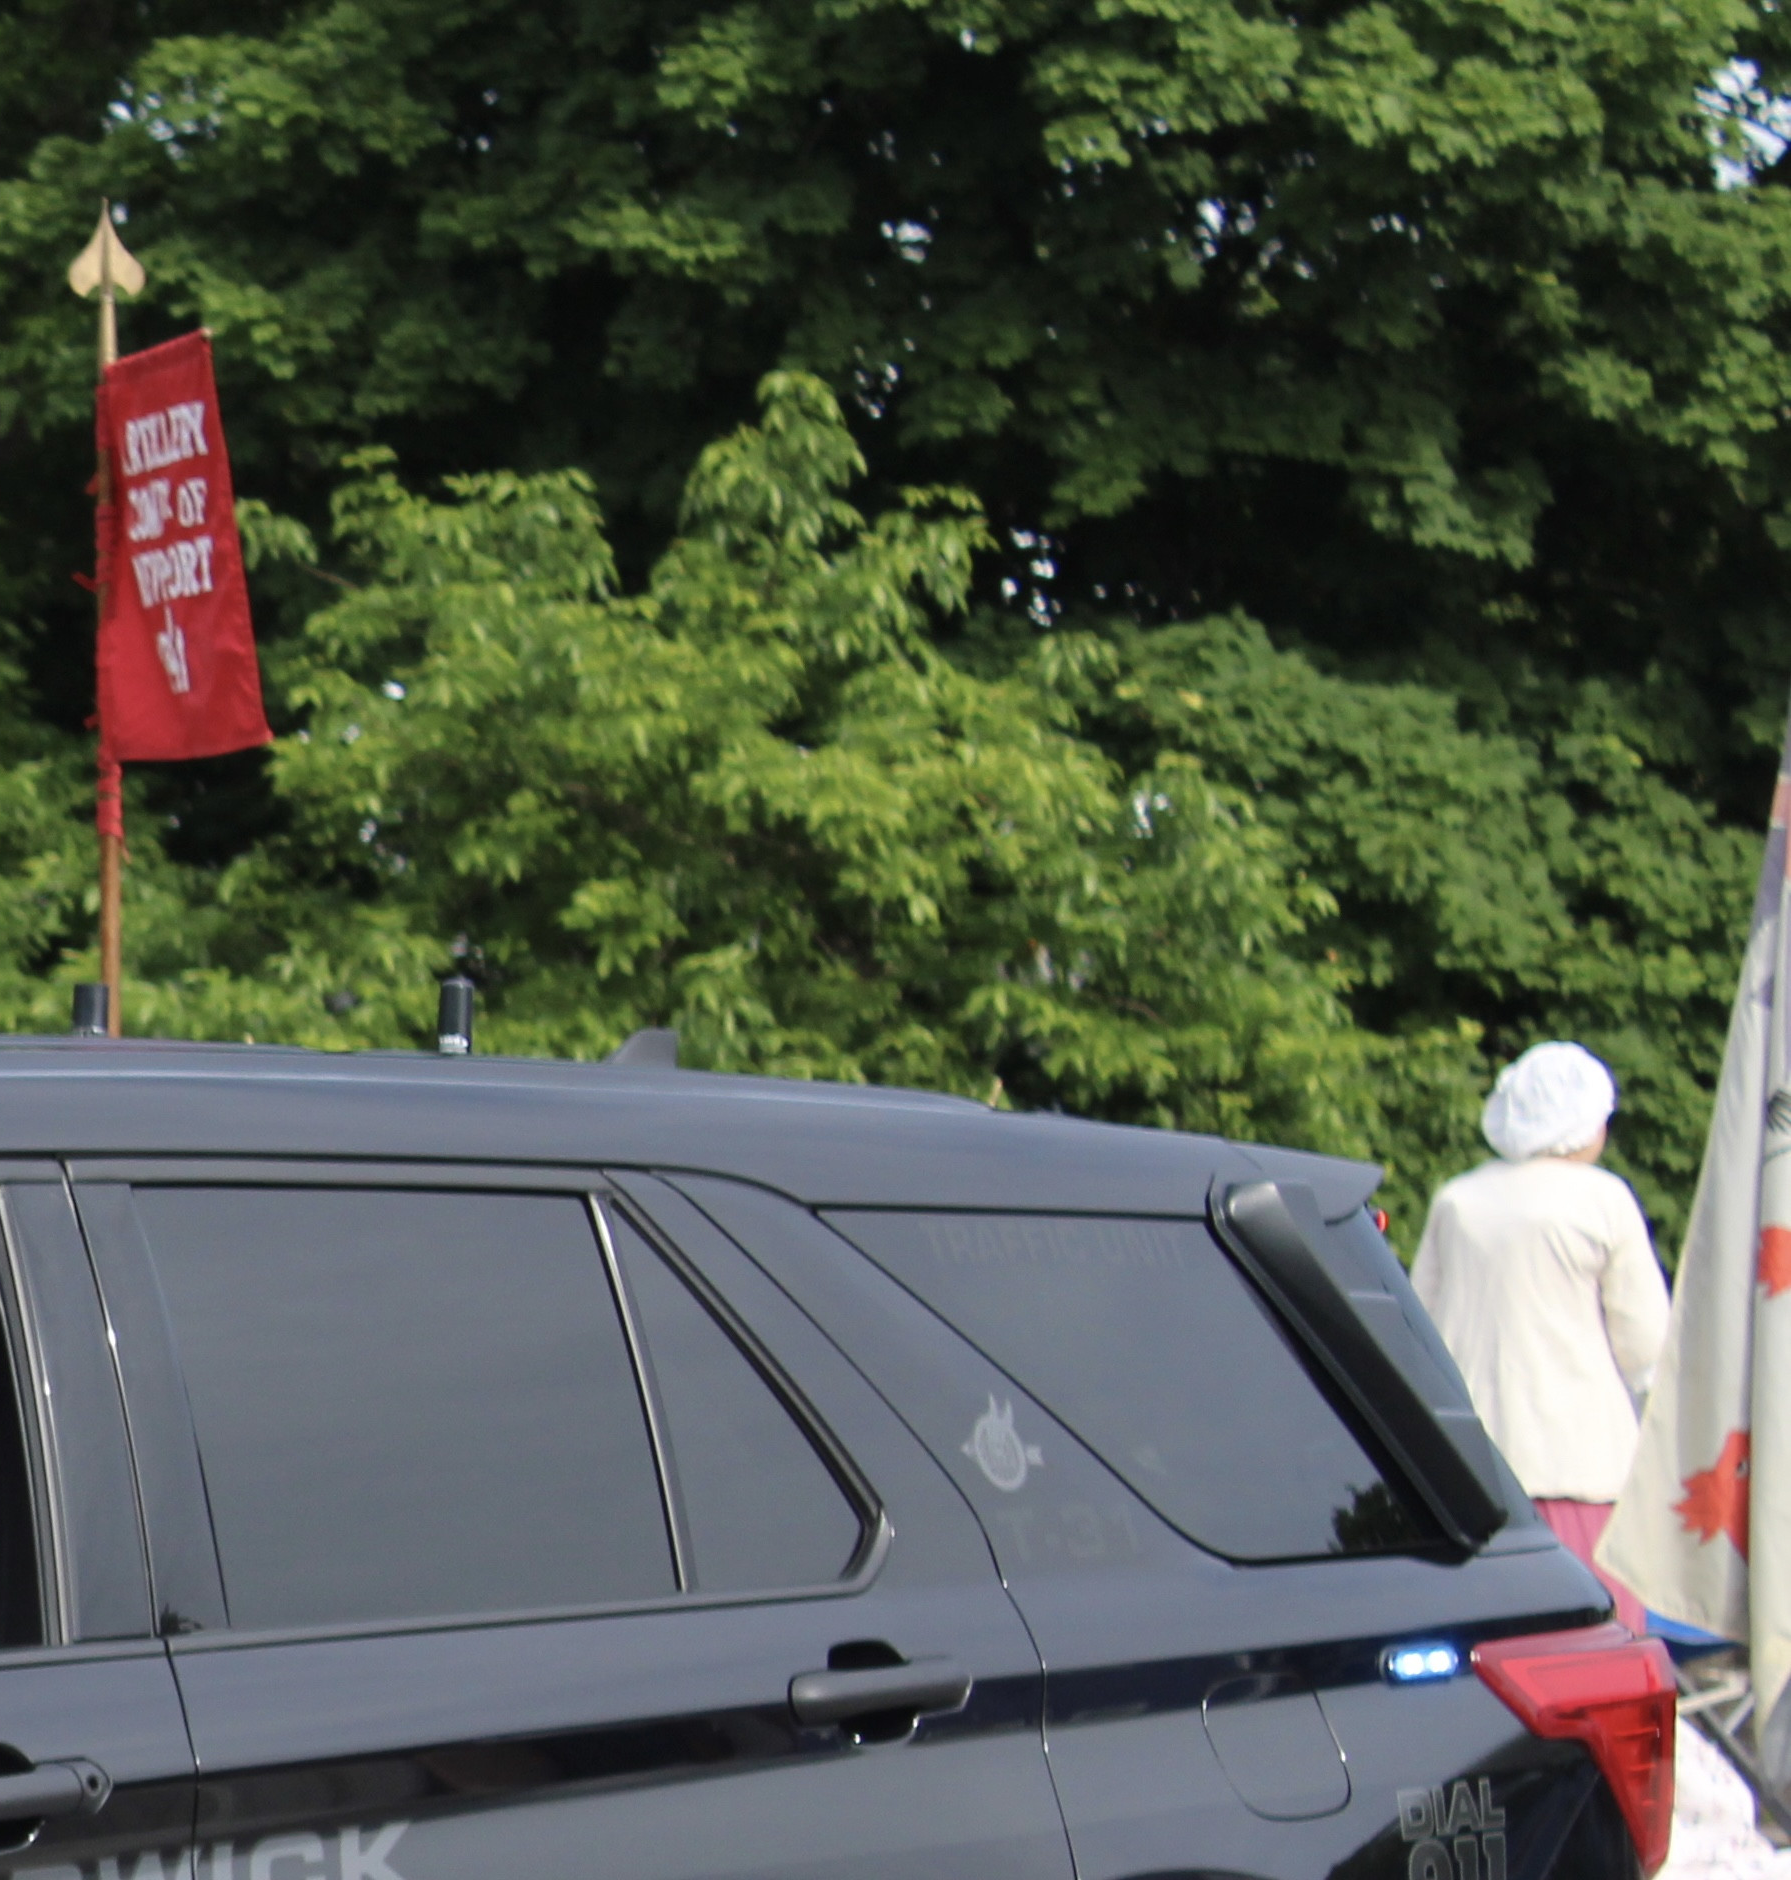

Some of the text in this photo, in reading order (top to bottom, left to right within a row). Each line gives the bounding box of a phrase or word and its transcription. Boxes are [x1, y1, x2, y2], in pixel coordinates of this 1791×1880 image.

[177, 479, 207, 528] OF
[919, 1221, 1186, 1266] TRAFFIC UNIT
[1397, 1777, 1505, 1841] DIAL
